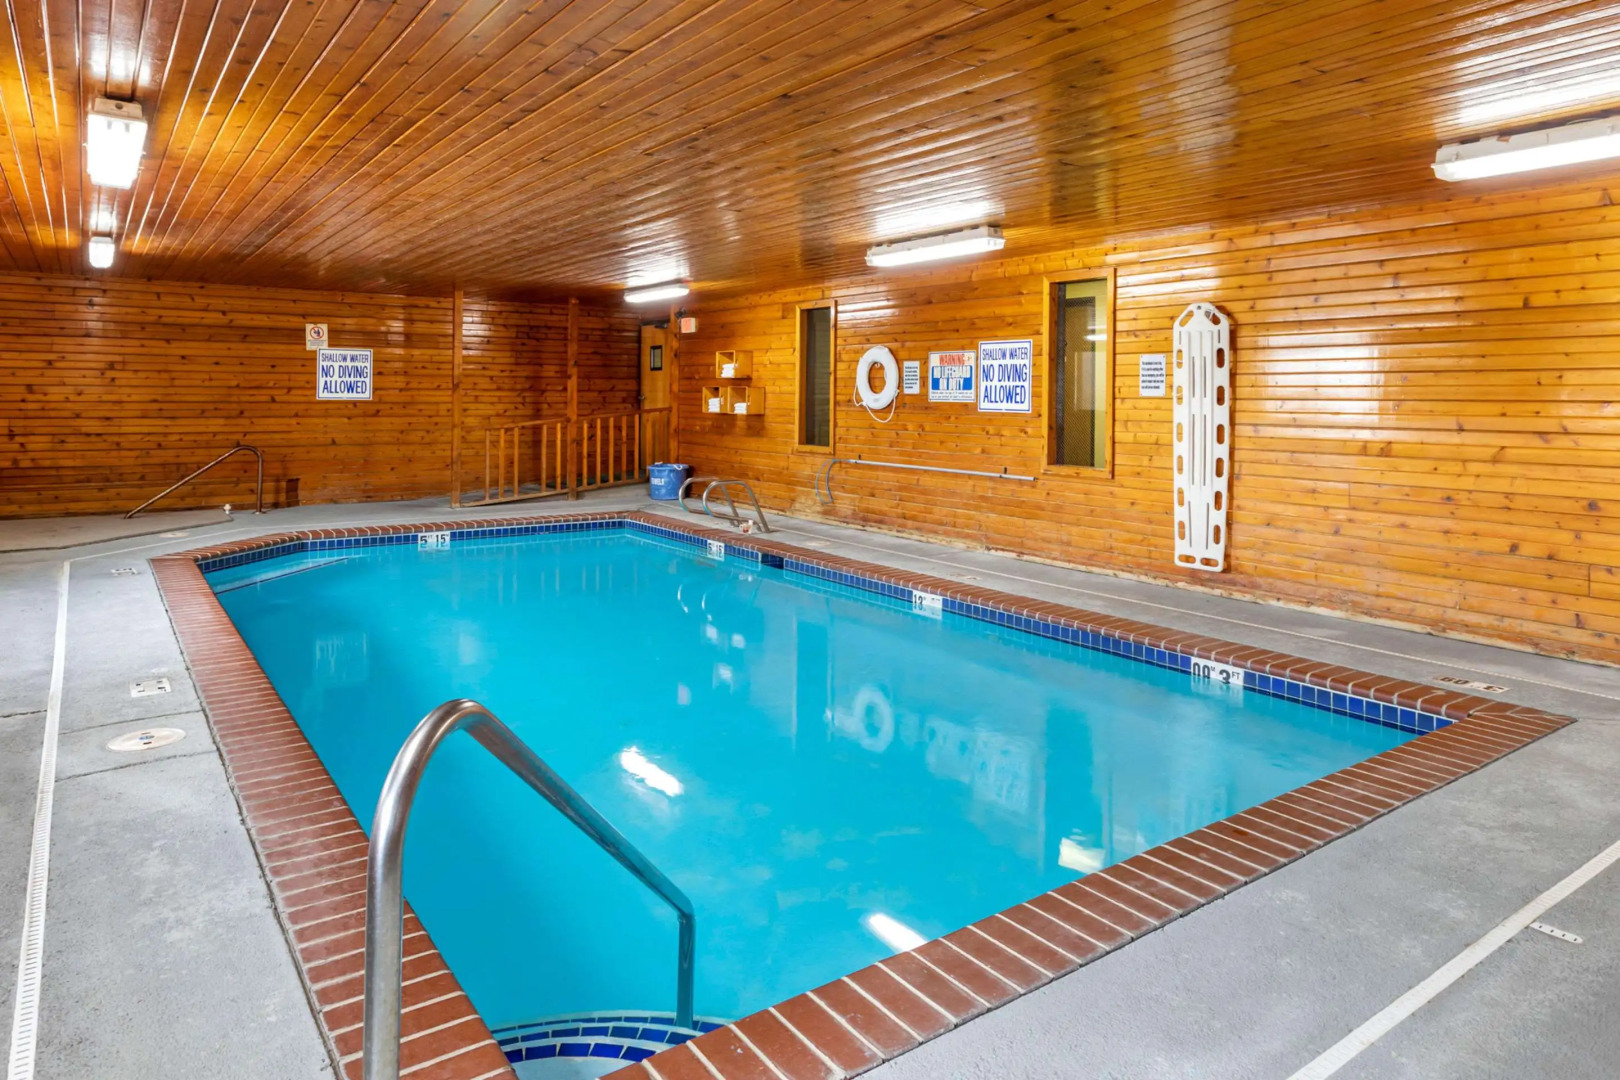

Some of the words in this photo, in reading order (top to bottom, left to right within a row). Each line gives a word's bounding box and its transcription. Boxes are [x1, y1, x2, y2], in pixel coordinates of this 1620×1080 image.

[321, 353, 348, 363] SHALLOW
[349, 354, 369, 363] WATER
[982, 348, 1006, 360] SHALLOW
[1009, 347, 1028, 360] WATER
[321, 365, 334, 378] NO
[338, 365, 369, 379] DIVING
[982, 364, 994, 382] NO
[997, 363, 1028, 383] DIVING
[322, 380, 367, 394] ALLOWED
[983, 385, 1027, 404] ALLOWED
[1231, 671, 1240, 680] FT
